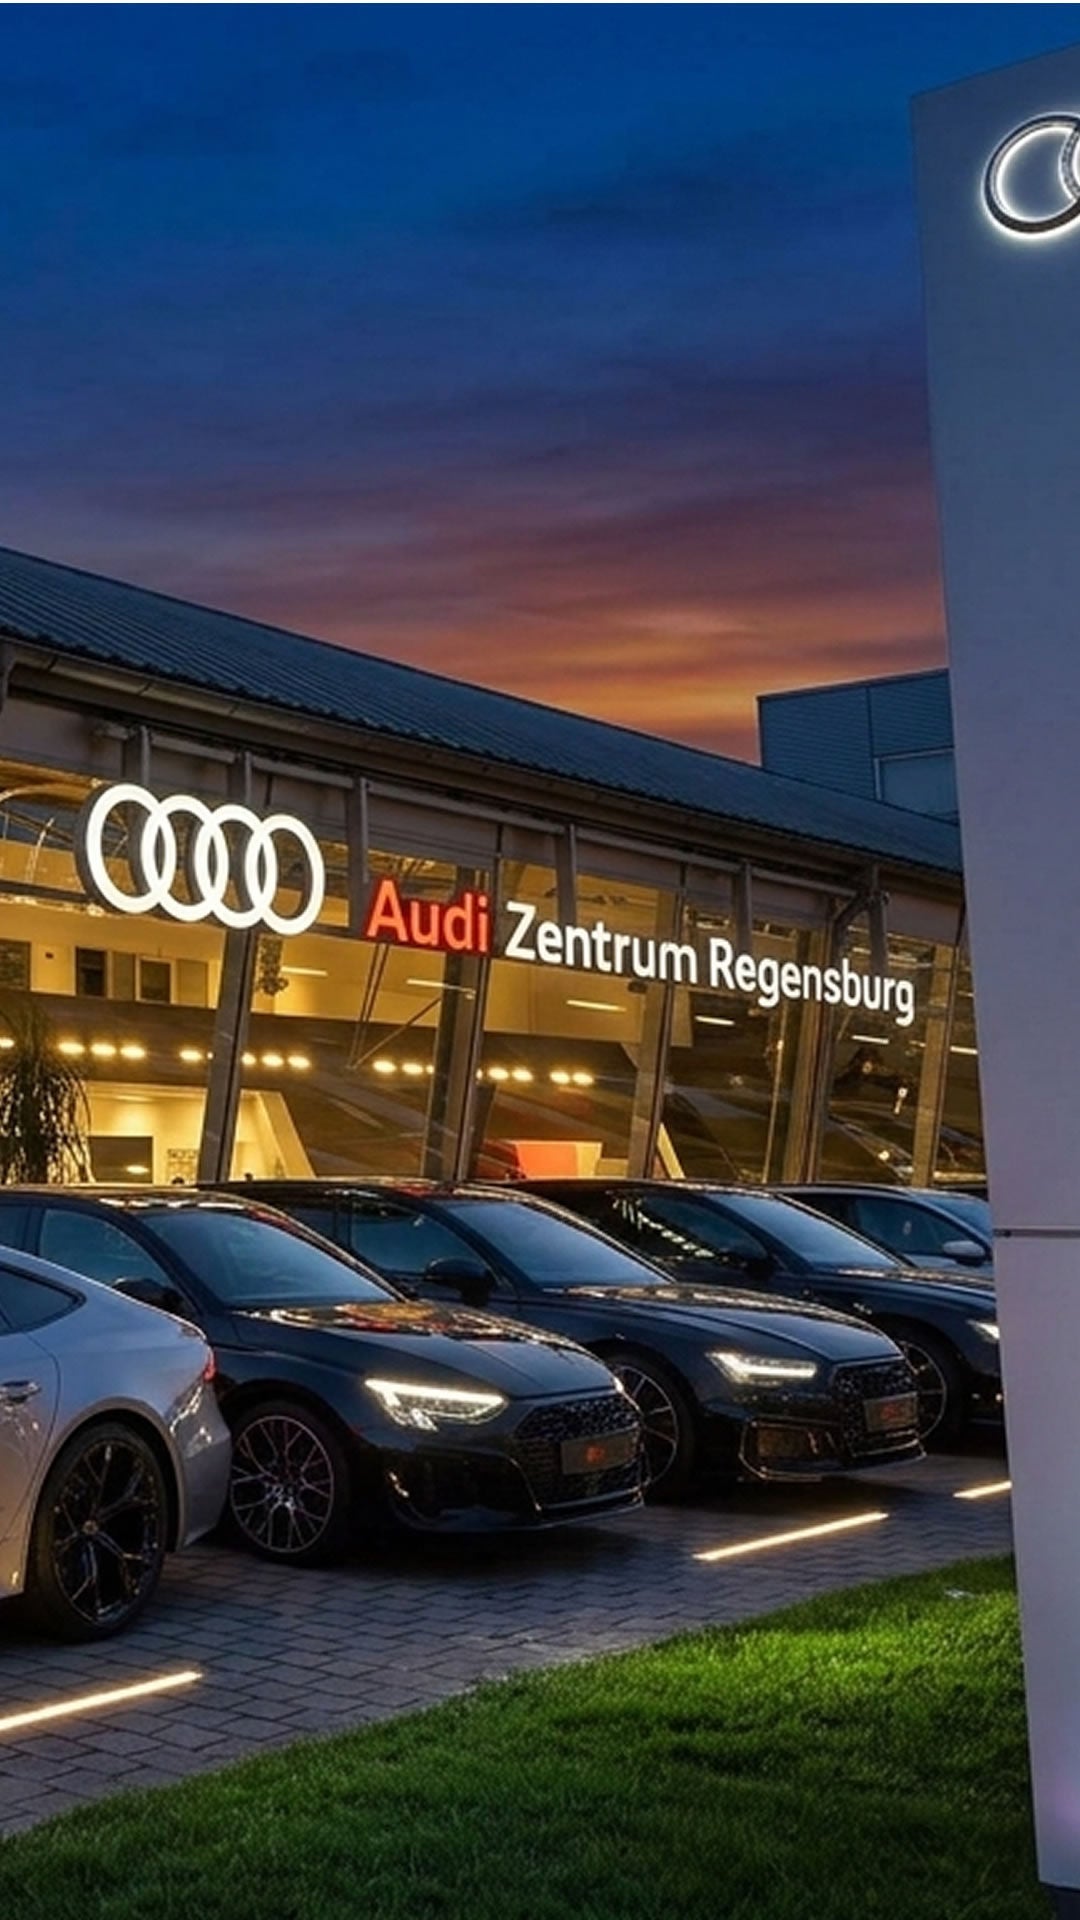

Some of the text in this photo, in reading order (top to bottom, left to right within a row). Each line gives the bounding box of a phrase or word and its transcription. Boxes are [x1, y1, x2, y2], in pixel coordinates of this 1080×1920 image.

[367, 879, 915, 1027] Audi Zentrum Regensburg
